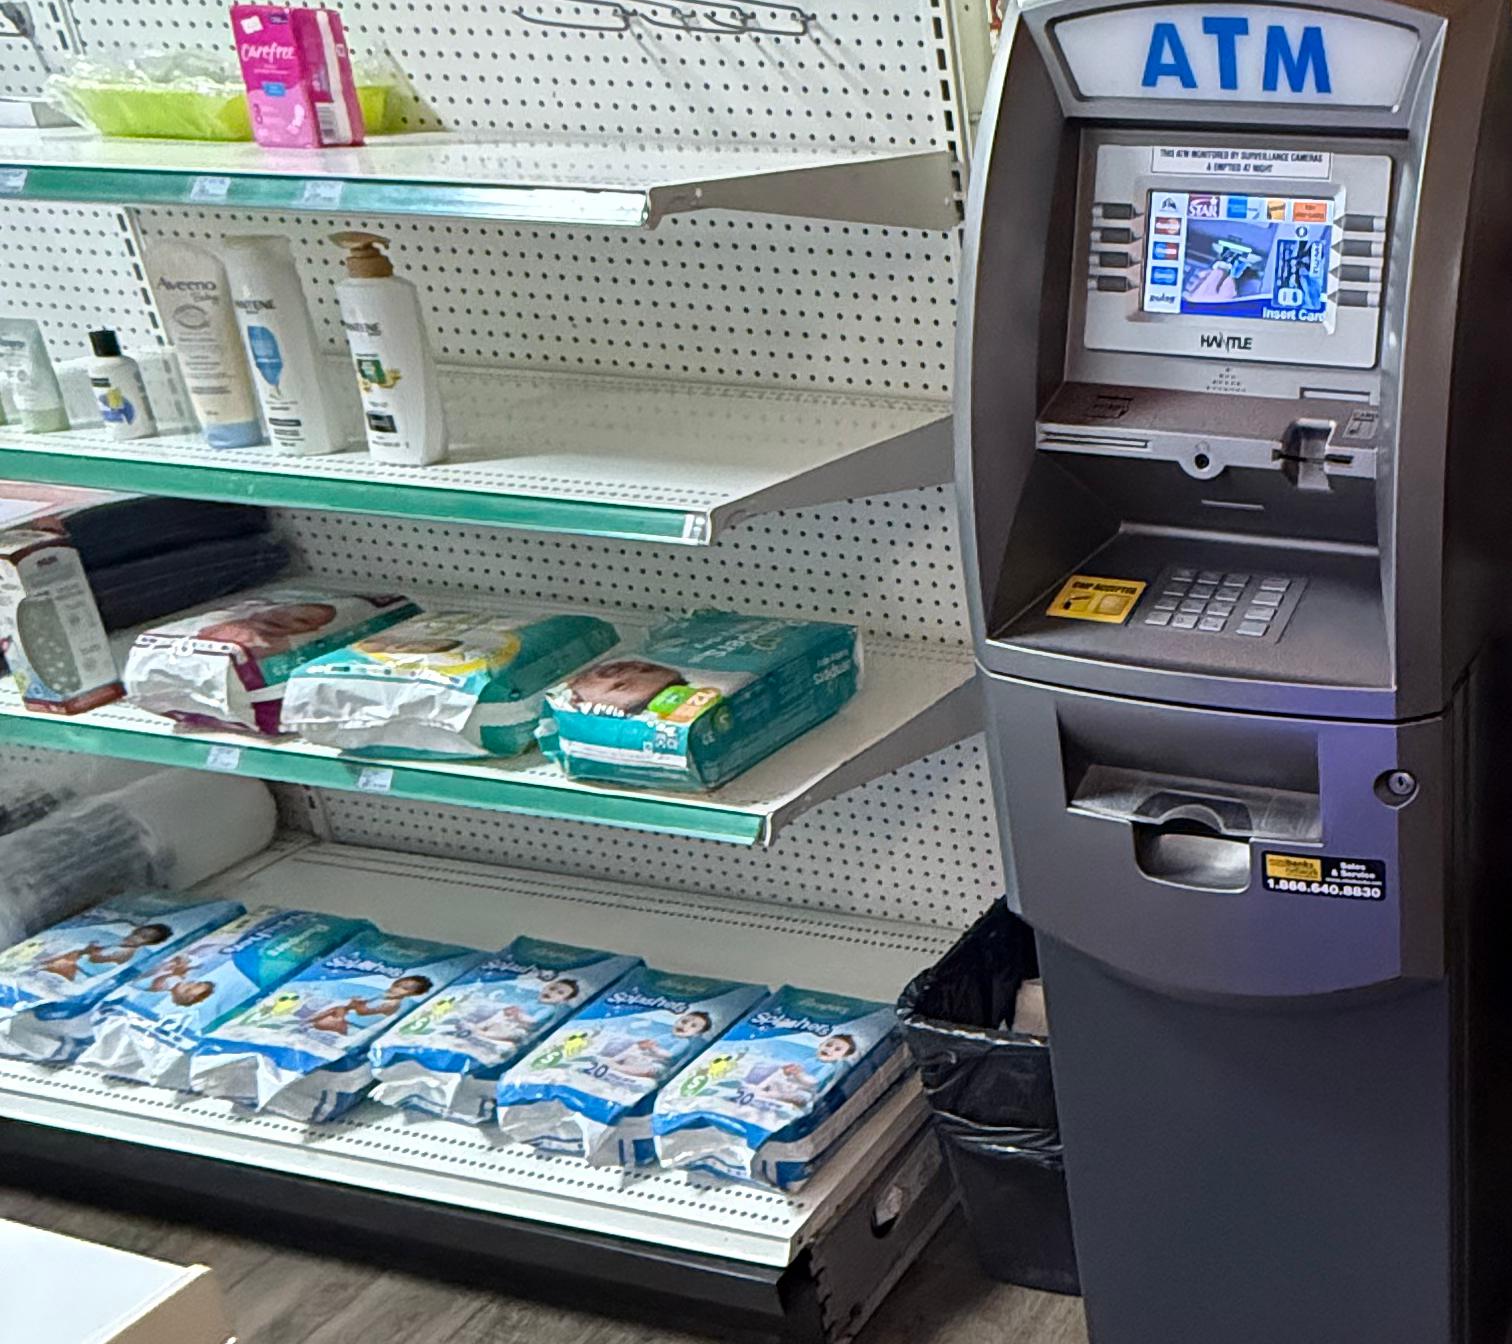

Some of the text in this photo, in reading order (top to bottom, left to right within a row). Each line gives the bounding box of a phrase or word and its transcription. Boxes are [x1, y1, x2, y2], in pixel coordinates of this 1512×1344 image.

[241, 42, 296, 63] Carefree
[1141, 16, 1332, 94] ATM
[1160, 149, 1175, 159] THIS
[1192, 150, 1229, 159] MONITORED
[1232, 151, 1240, 160] BY
[1241, 152, 1289, 162] SURVEILLANCE
[1291, 153, 1323, 163] CAMERAS
[1189, 202, 1218, 218] STAR
[156, 276, 217, 292] Aveeno
[1262, 307, 1326, 322] Insert Card
[1266, 877, 1382, 899] 1.866.640.8830
[584, 1062, 609, 1079] 20
[733, 1089, 755, 1105] 20
